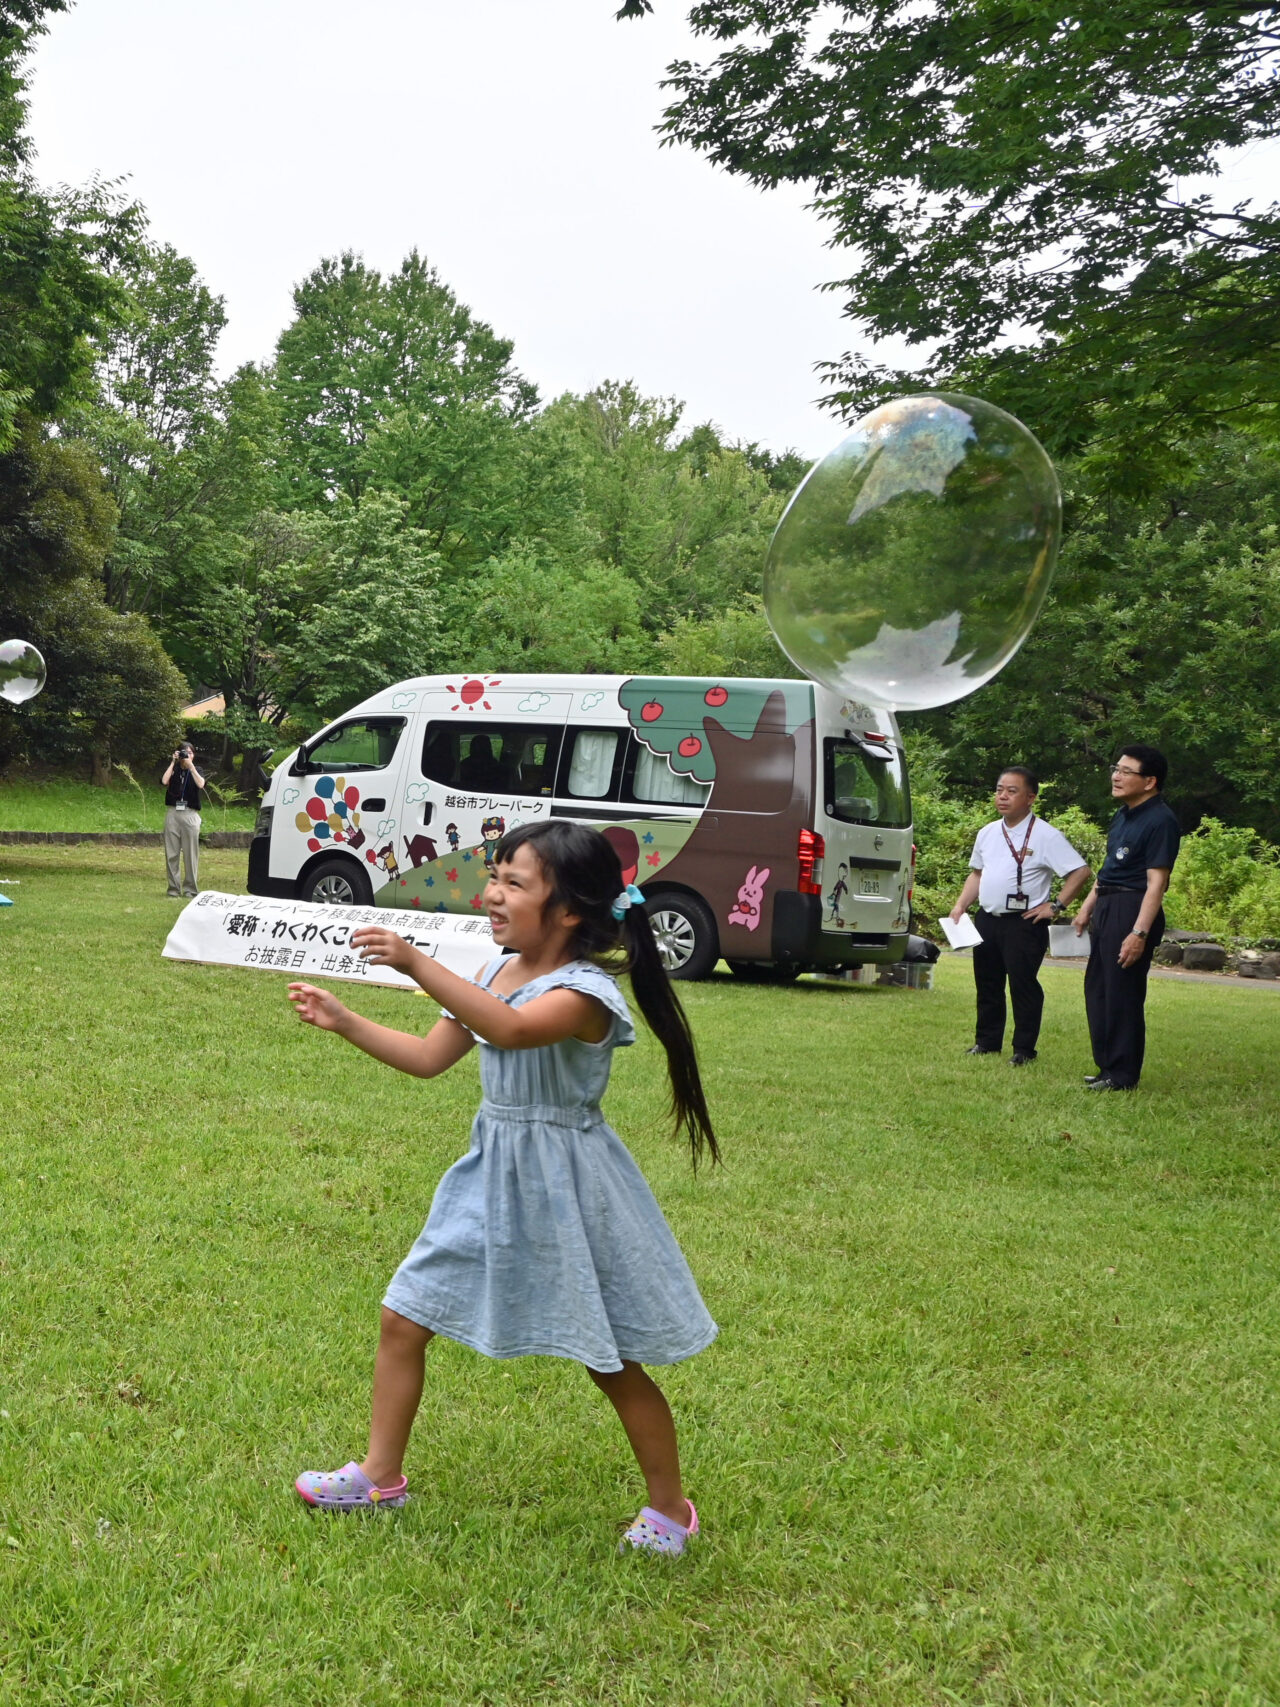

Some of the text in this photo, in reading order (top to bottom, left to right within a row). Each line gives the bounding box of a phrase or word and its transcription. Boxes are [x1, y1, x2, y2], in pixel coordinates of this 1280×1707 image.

[445, 795, 544, 813] 越谷市プレーパーク
[244, 945, 372, 976] お披露目・出発式
